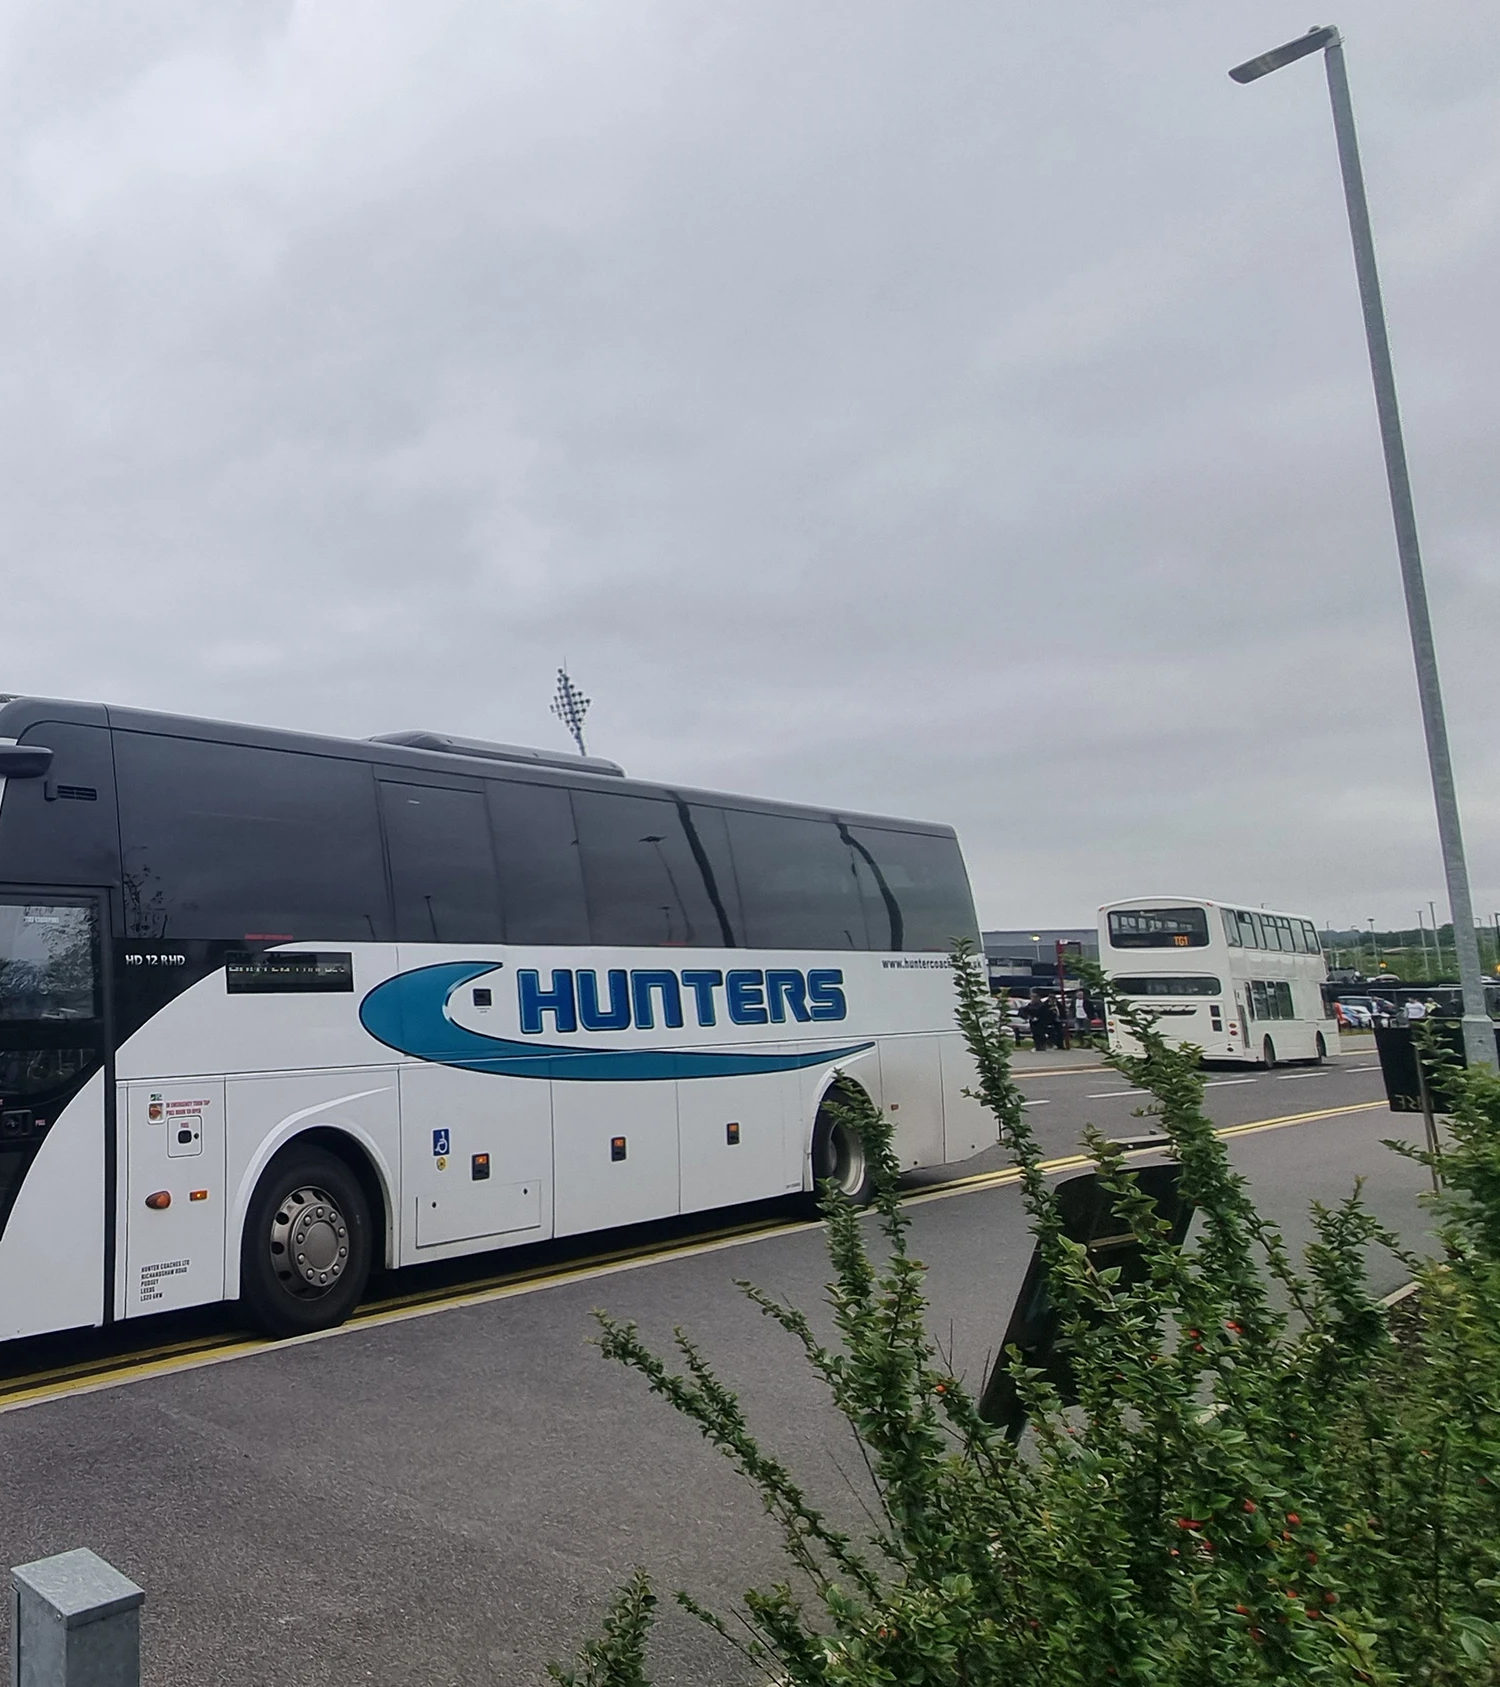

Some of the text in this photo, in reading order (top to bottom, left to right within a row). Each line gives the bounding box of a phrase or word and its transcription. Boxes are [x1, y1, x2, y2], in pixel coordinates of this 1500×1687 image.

[125, 954, 186, 966] HD 12 RHD
[516, 968, 847, 1034] HUNTERS
[141, 1264, 160, 1273] HUNTER
[160, 1261, 181, 1269] COACHES
